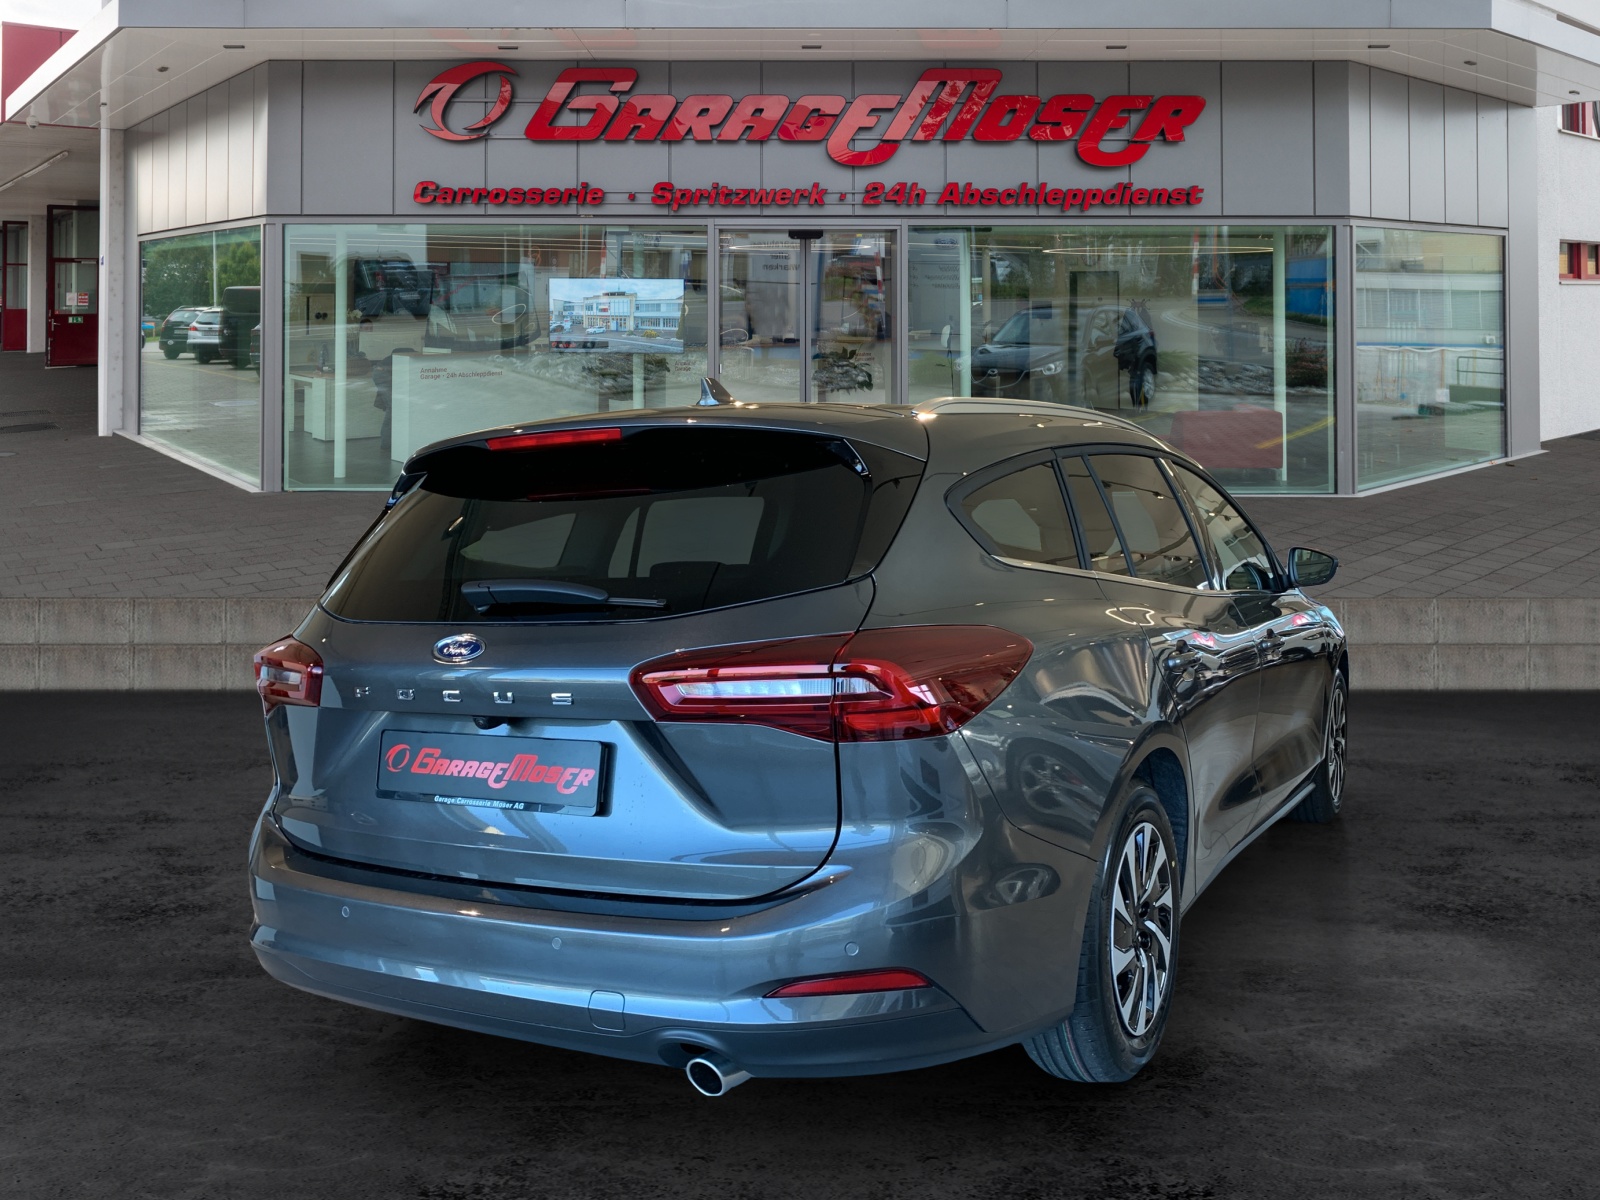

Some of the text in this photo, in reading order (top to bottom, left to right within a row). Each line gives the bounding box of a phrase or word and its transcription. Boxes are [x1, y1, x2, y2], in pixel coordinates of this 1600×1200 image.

[413, 181, 604, 205] Carrosserie
[651, 182, 827, 211] Spritzwerk
[863, 182, 926, 205] 24h
[937, 182, 1204, 211] Abschleppdienst
[458, 370, 503, 378] Abschleppdienst
[354, 686, 574, 705] FOCUS
[434, 795, 455, 804] Garage
[456, 797, 491, 807] Carrosserie
[493, 800, 512, 809] Moser
